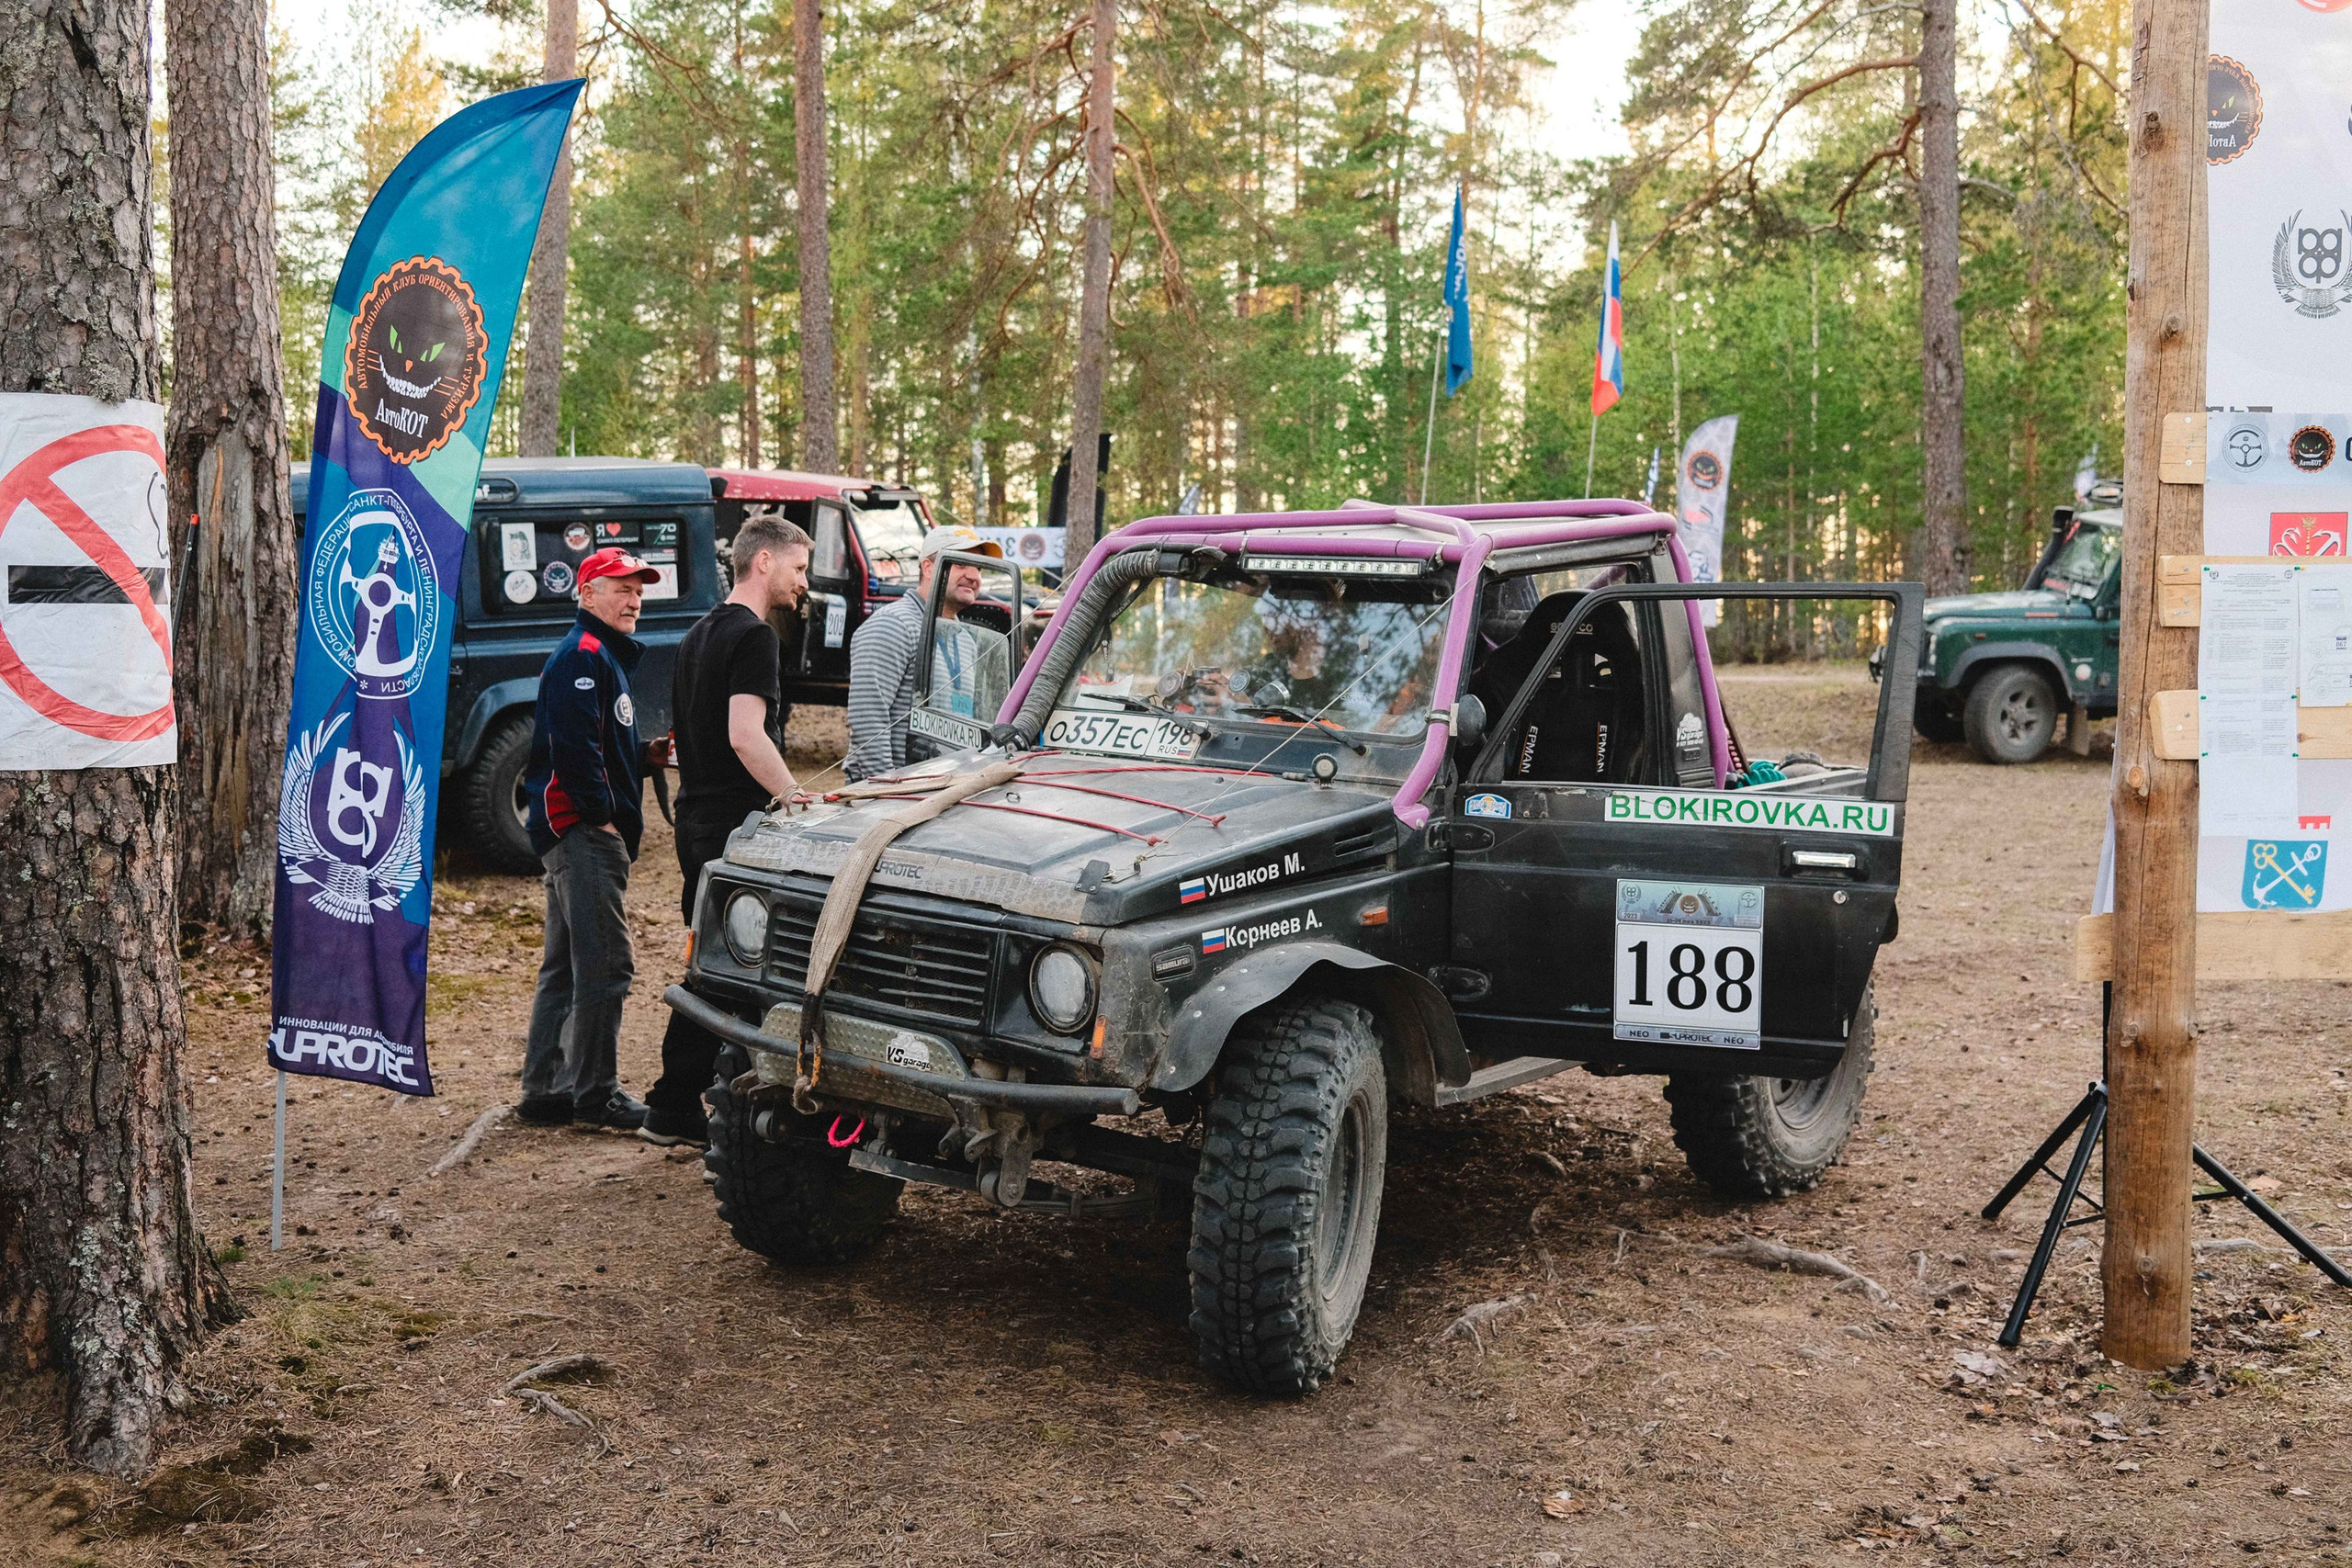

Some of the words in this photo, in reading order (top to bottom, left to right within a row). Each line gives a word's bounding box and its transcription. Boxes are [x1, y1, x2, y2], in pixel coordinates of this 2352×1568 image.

[392, 274, 416, 292] КЛУБ
[418, 274, 475, 348] ОРИЕНТИРОВАНИЯ
[356, 287, 391, 389] АВТОМОБИЛЬНЫЙ
[440, 367, 472, 420] ТУРИЗМА
[314, 581, 357, 673] ОМОБИЛЬНАЯ
[829, 613, 844, 636] 202
[912, 711, 981, 749] BLOKIROVKA.RU
[1521, 725, 1539, 773] EPMAN
[1597, 724, 1608, 773] EPMAN
[1158, 745, 1177, 755] RUS
[1611, 795, 1888, 831] BLOKIROVKA.RU
[874, 860, 924, 879] UPROTEC
[1205, 862, 1280, 897] Ушаков
[1283, 852, 1306, 874] М.
[1224, 917, 1301, 949] Корнеев
[1305, 908, 1323, 930] А.
[1156, 957, 1191, 972] samurai
[1627, 941, 1756, 1013] 188
[278, 1015, 347, 1033] ИННОВАЦИИ
[348, 1025, 372, 1037] ДЛЯ
[1629, 1030, 1649, 1038] NEO
[1668, 1032, 1713, 1043] SUPROTEC
[1724, 1036, 1744, 1044] NEO
[888, 1046, 904, 1063] VS
